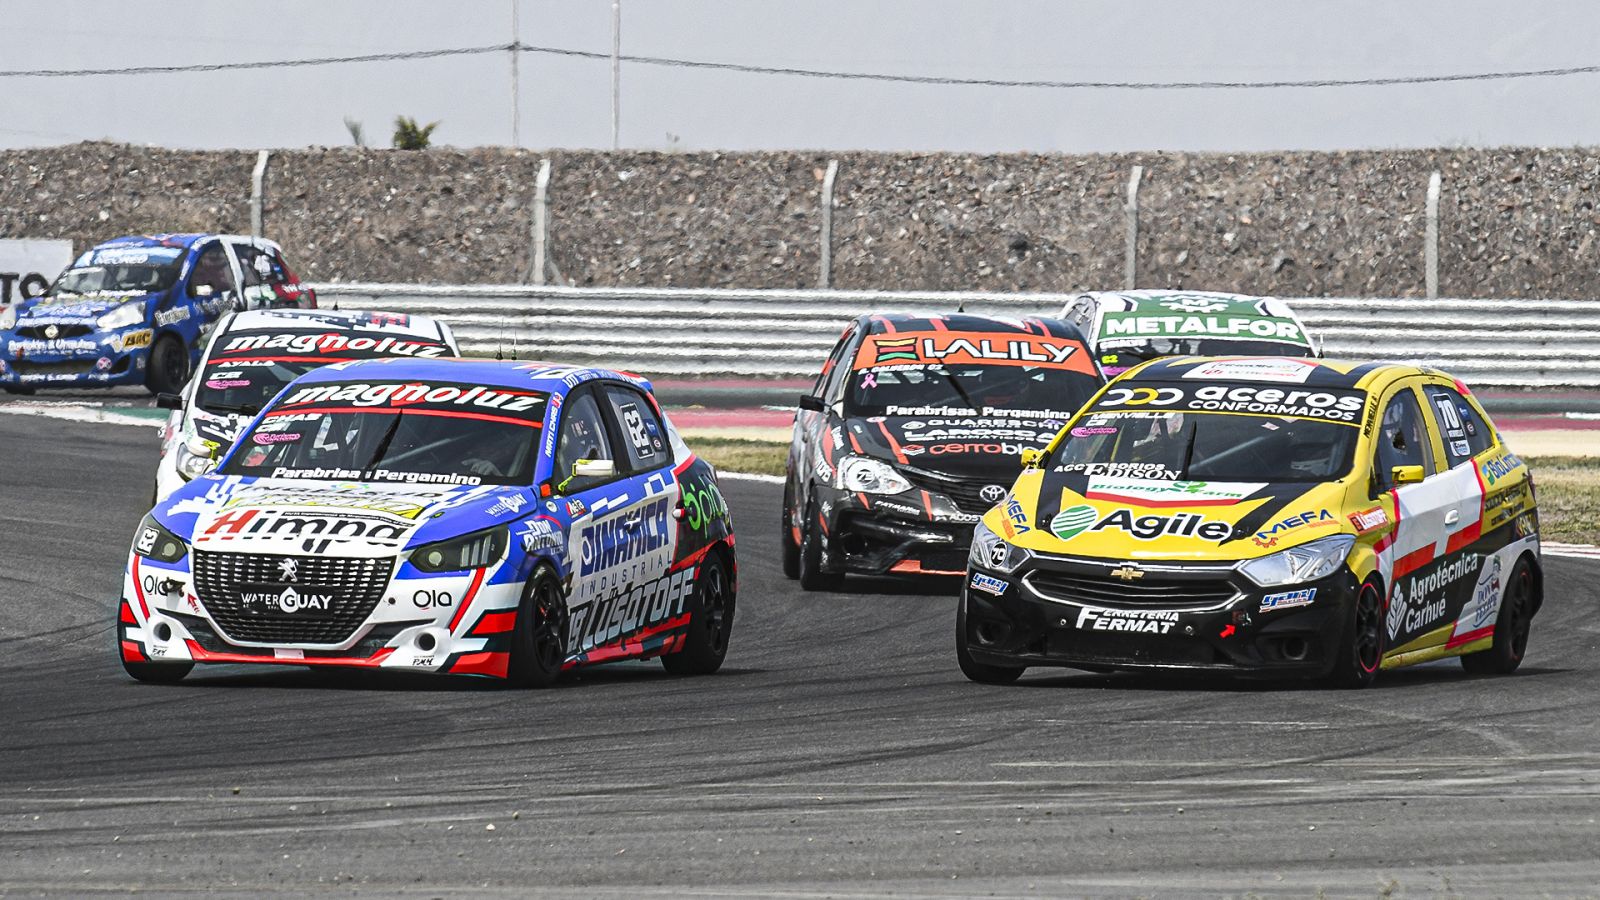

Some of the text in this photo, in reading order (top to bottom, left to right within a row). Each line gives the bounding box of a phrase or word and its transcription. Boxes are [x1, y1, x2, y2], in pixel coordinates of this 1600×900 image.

[1106, 316, 1299, 338] METALFOR
[223, 332, 447, 358] magnoluz
[922, 338, 1080, 363] LALILY
[283, 382, 545, 412] magnoluz
[1195, 386, 1364, 411] aceros
[261, 413, 323, 424] CHAS
[886, 405, 1071, 420] Parabrisas Pergamino
[1188, 400, 1355, 421] CONFORMADOS
[1437, 399, 1460, 429] 70
[374, 469, 482, 486] Pergamino
[1091, 510, 1229, 539] Agile
[1256, 509, 1333, 539] MEFA
[991, 547, 1005, 561] 70
[581, 551, 672, 598] INDUSTRIAL
[1409, 553, 1478, 604] Agrotécnica
[413, 589, 452, 607] Ola
[1076, 607, 1176, 634] FERMAT
[1405, 591, 1446, 633] Carhué
